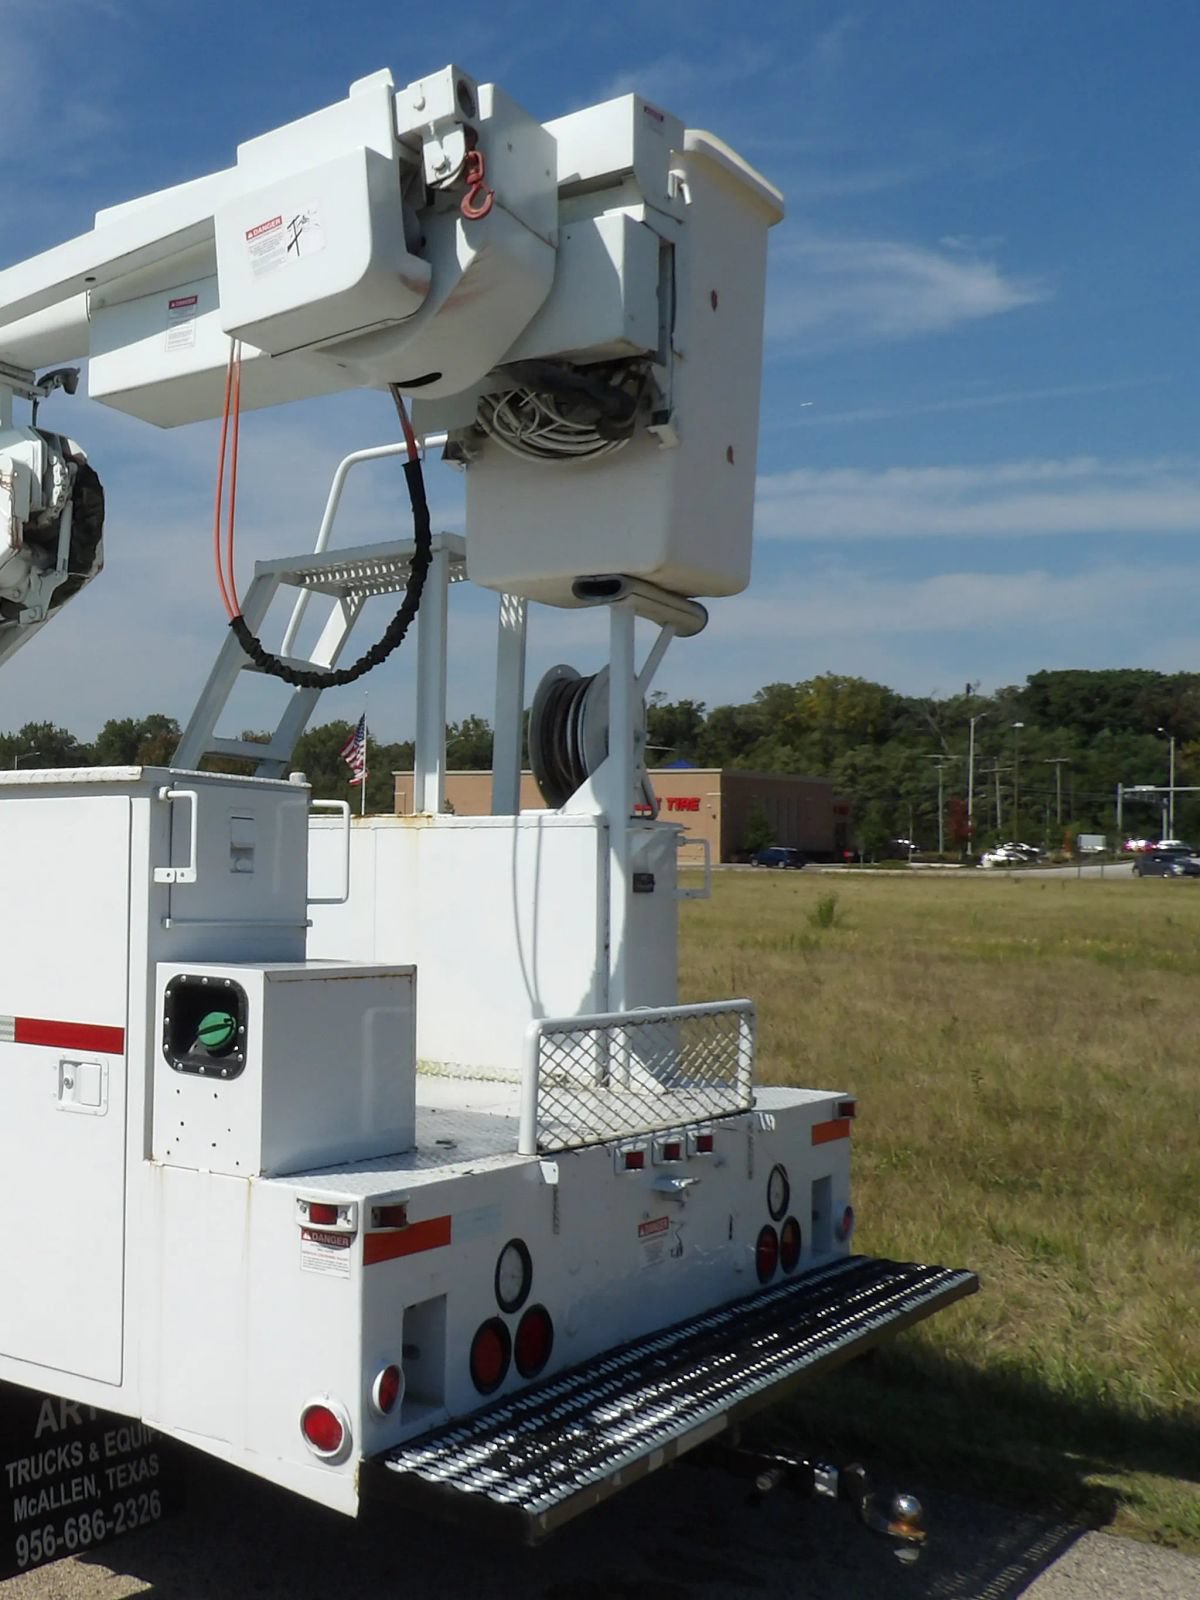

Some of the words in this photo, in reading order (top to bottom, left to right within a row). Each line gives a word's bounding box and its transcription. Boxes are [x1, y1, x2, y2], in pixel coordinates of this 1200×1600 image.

[666, 797, 701, 812] TIRE
[311, 1231, 350, 1247] DANGER
[5, 1441, 83, 1489] TRUCKS
[88, 1442, 100, 1463] &
[13, 1473, 101, 1523] McALLEN,
[105, 1453, 160, 1491] TEXAS
[16, 1489, 161, 1568] 956-686-2326
